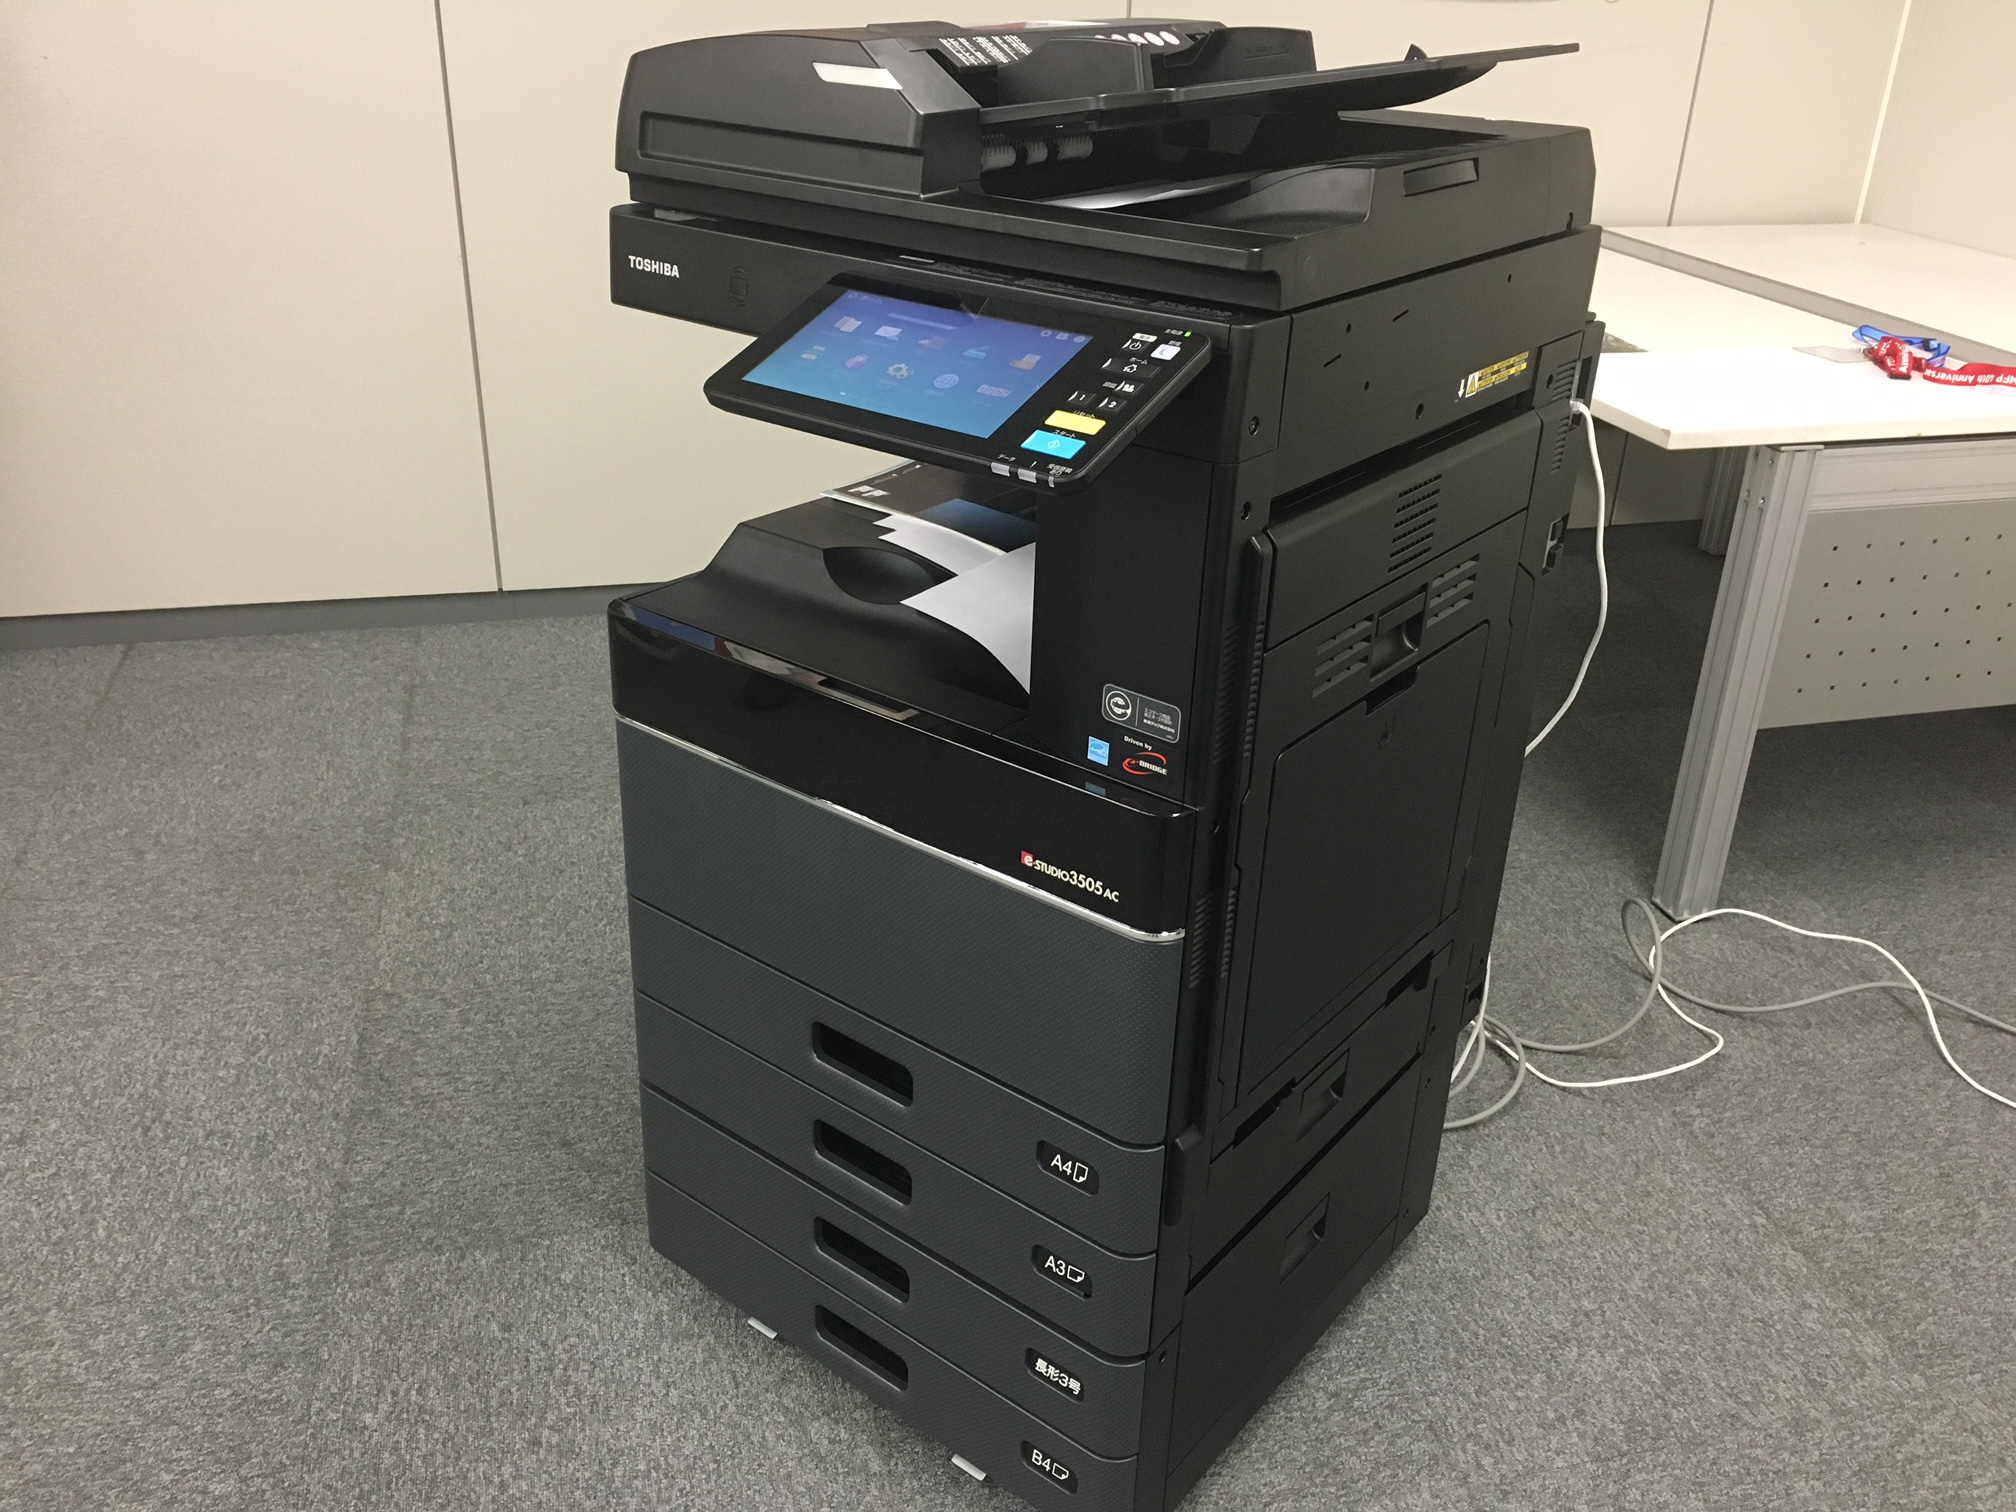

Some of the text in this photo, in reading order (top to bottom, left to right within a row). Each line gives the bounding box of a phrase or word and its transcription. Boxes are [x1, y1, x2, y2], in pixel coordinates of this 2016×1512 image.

[628, 255, 680, 279] TOSHIBA
[1996, 373, 2016, 386] MFP
[1123, 735, 1153, 752] Driven by
[1050, 1154, 1073, 1177] A4
[1044, 1255, 1066, 1277] A3
[1034, 1357, 1081, 1396] 長形3号
[1031, 1448, 1051, 1472] B4
